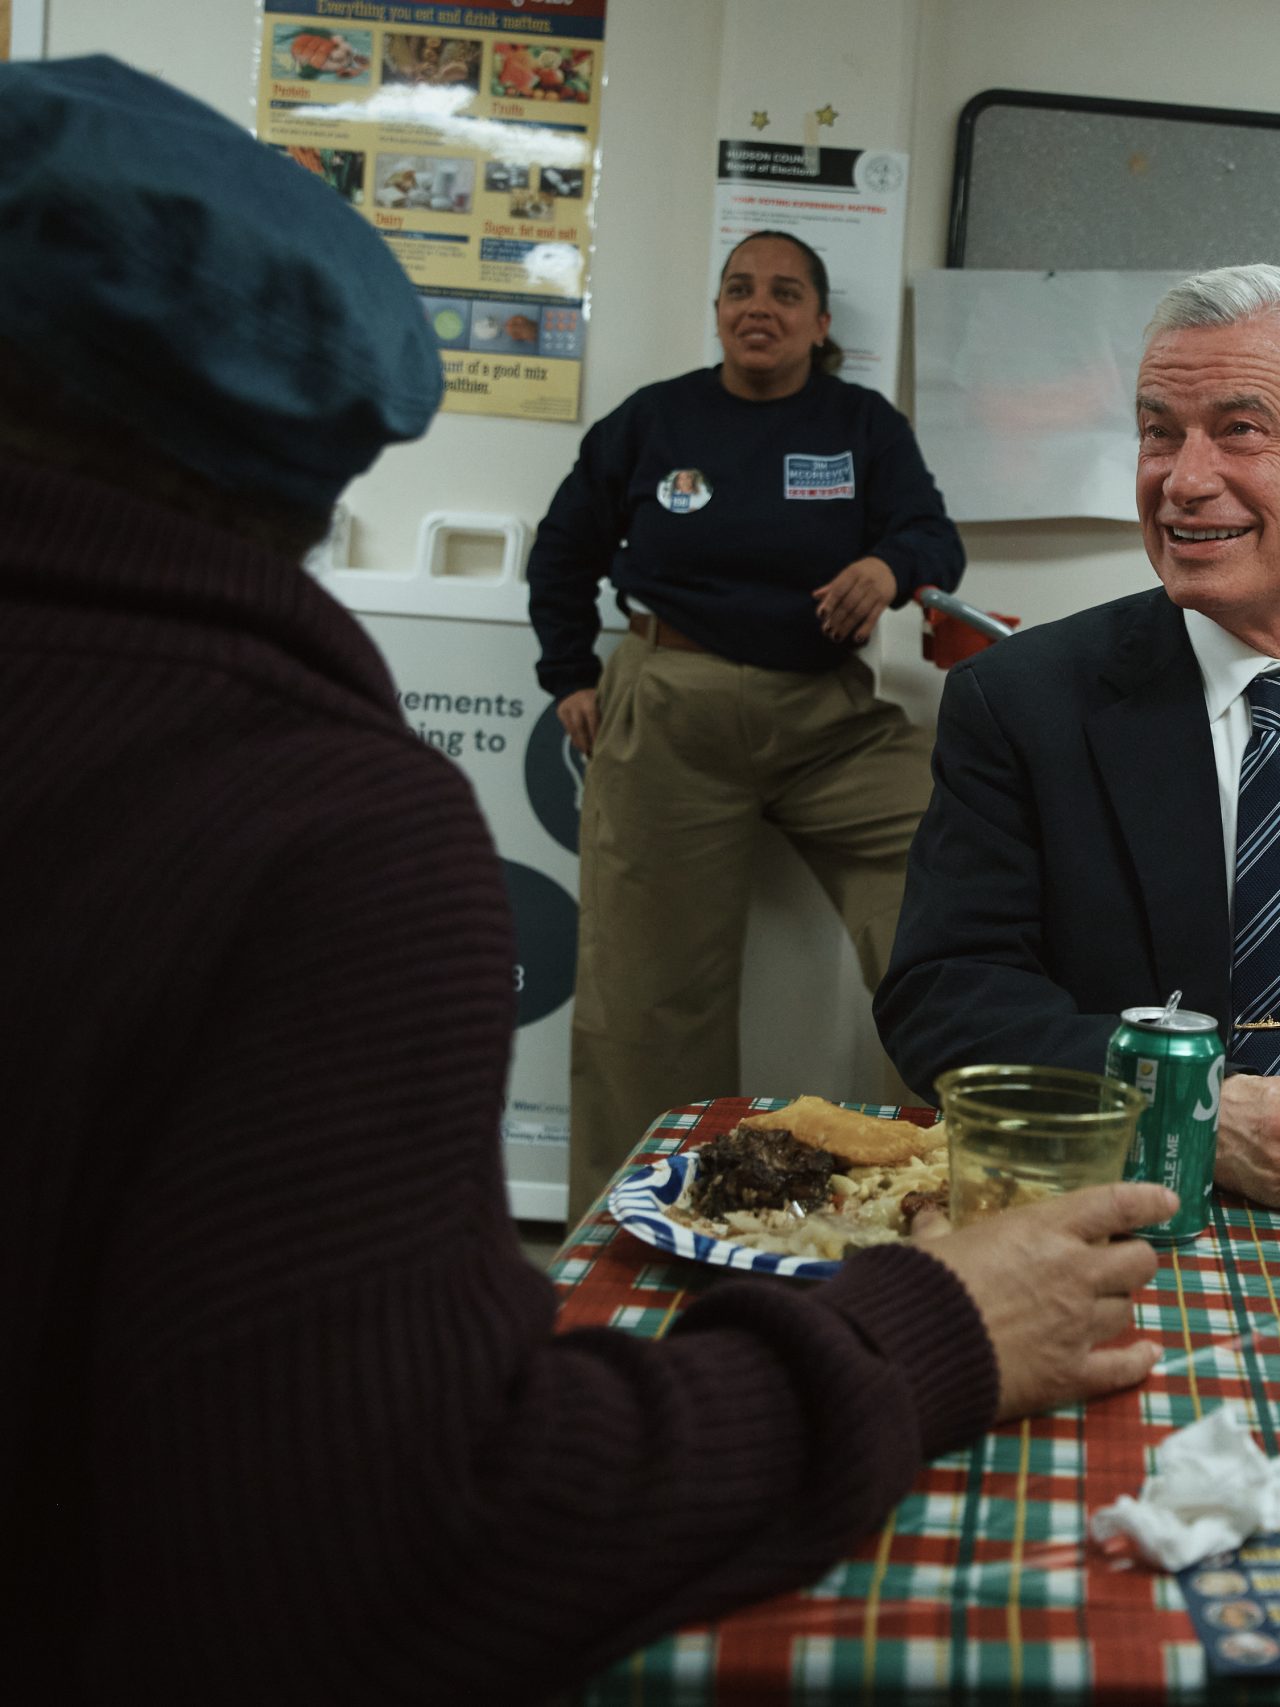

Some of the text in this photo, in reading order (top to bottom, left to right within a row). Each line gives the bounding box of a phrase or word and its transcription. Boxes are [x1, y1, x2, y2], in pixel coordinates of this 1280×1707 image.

[317, 0, 386, 22] Everything
[389, 7, 412, 24] you
[415, 10, 434, 22] eat
[438, 10, 461, 25] and
[463, 11, 498, 28] drink
[272, 83, 311, 99] Protein
[727, 150, 772, 162] HUDSON
[726, 161, 757, 172] Board
[758, 163, 770, 173] of
[376, 212, 404, 230] Dairy
[536, 226, 554, 238] and
[468, 361, 480, 374] of
[493, 364, 521, 381] good
[525, 366, 548, 381] mix
[397, 690, 525, 719] ements
[408, 722, 507, 757] ing to
[1158, 1133, 1180, 1231] RCLE ME
